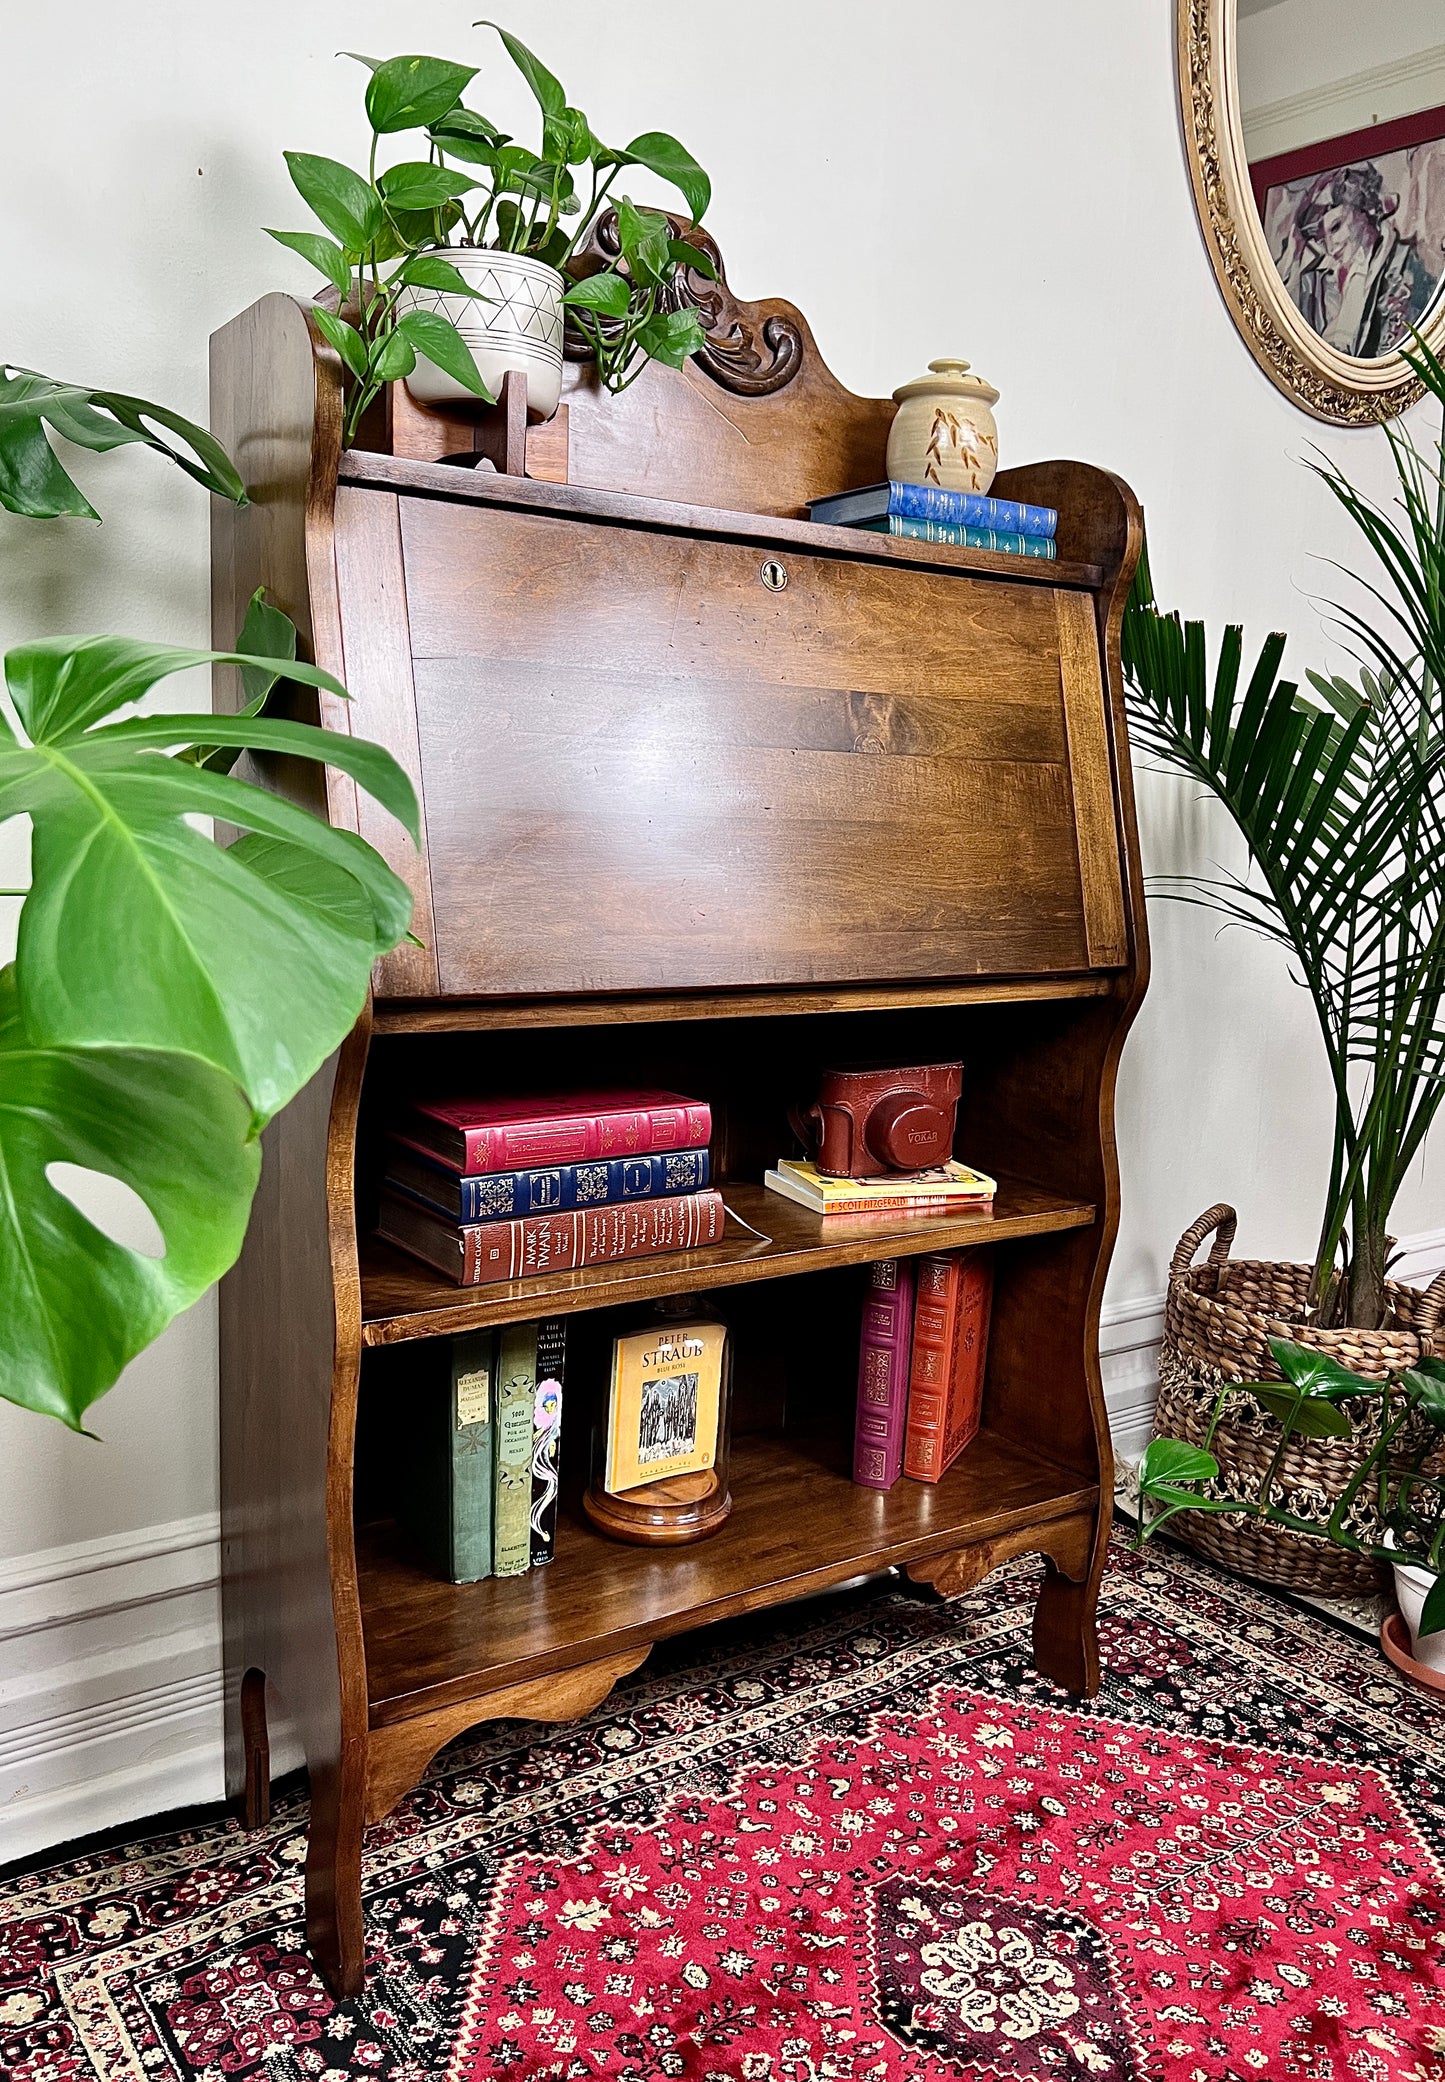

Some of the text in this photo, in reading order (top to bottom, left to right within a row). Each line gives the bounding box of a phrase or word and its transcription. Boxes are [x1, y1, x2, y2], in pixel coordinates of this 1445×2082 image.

[908, 1131, 938, 1143] VOKAR
[839, 1201, 862, 1211] SCOTT
[863, 1198, 906, 1209] FITZGERALD
[708, 1200, 716, 1238] GRAMERCY
[525, 1229, 537, 1265] MARK
[537, 1221, 551, 1269] TWAIN
[473, 1228, 482, 1283] LITERARY CLASSICS
[658, 1333, 689, 1346] PETER
[642, 1345, 702, 1368] STRAUB
[657, 1362, 686, 1373] BLUE ROSE
[463, 1383, 484, 1392] DUMAS
